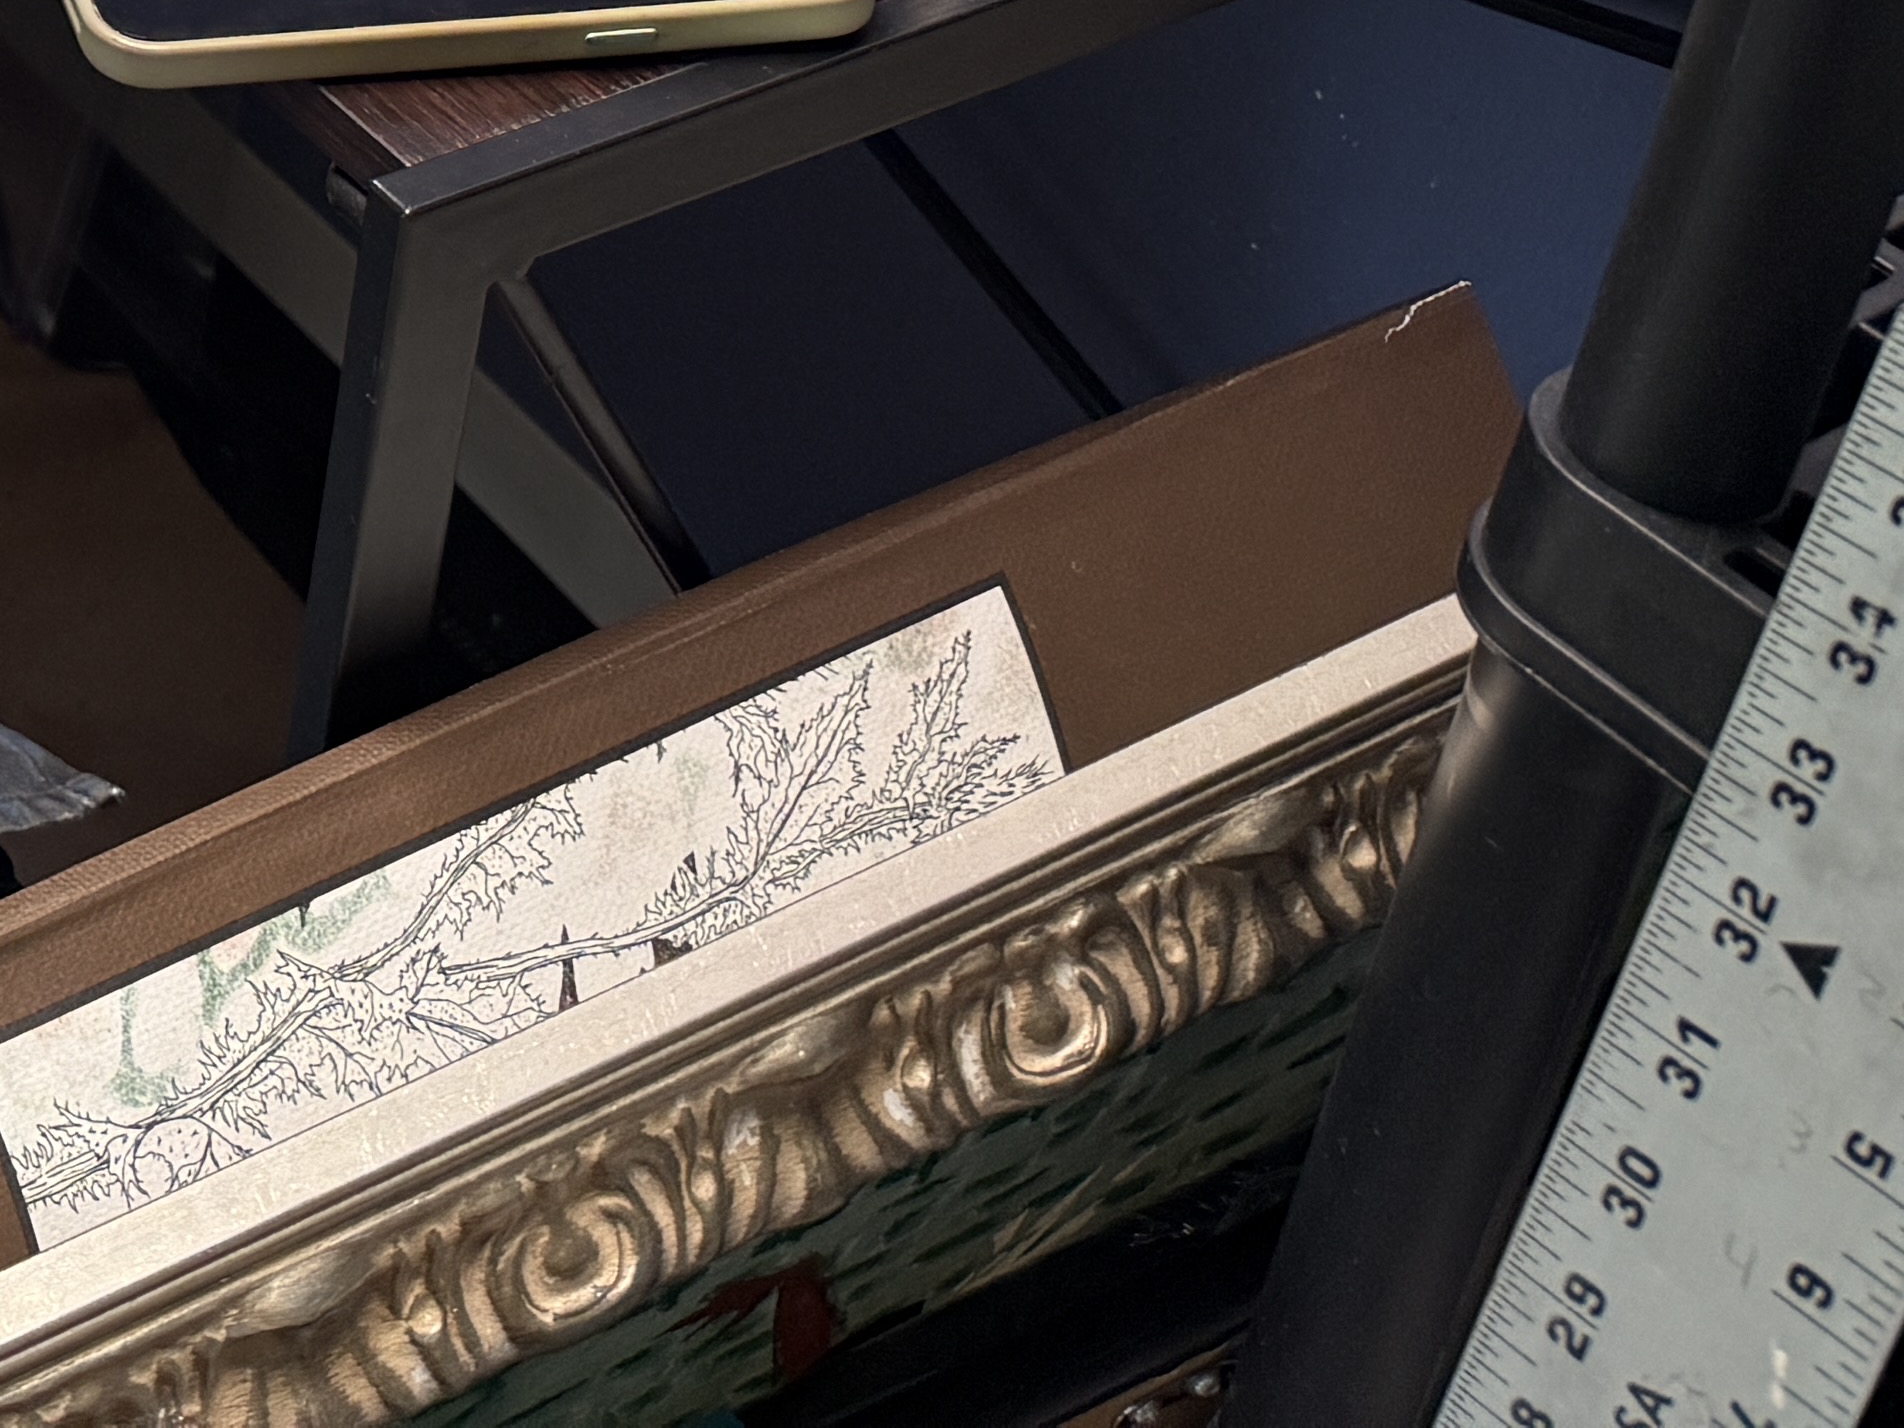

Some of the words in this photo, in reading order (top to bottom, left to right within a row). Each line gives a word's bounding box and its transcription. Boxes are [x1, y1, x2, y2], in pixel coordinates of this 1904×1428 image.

[1546, 1271, 1607, 1363] 29
[1601, 1145, 1663, 1230] 30
[1657, 1015, 1721, 1101] 31
[1713, 876, 1779, 964] 32
[1769, 737, 1837, 827] 33
[1828, 595, 1897, 686] 34
[1843, 1129, 1895, 1181] 5
[1785, 1262, 1836, 1312] 6
